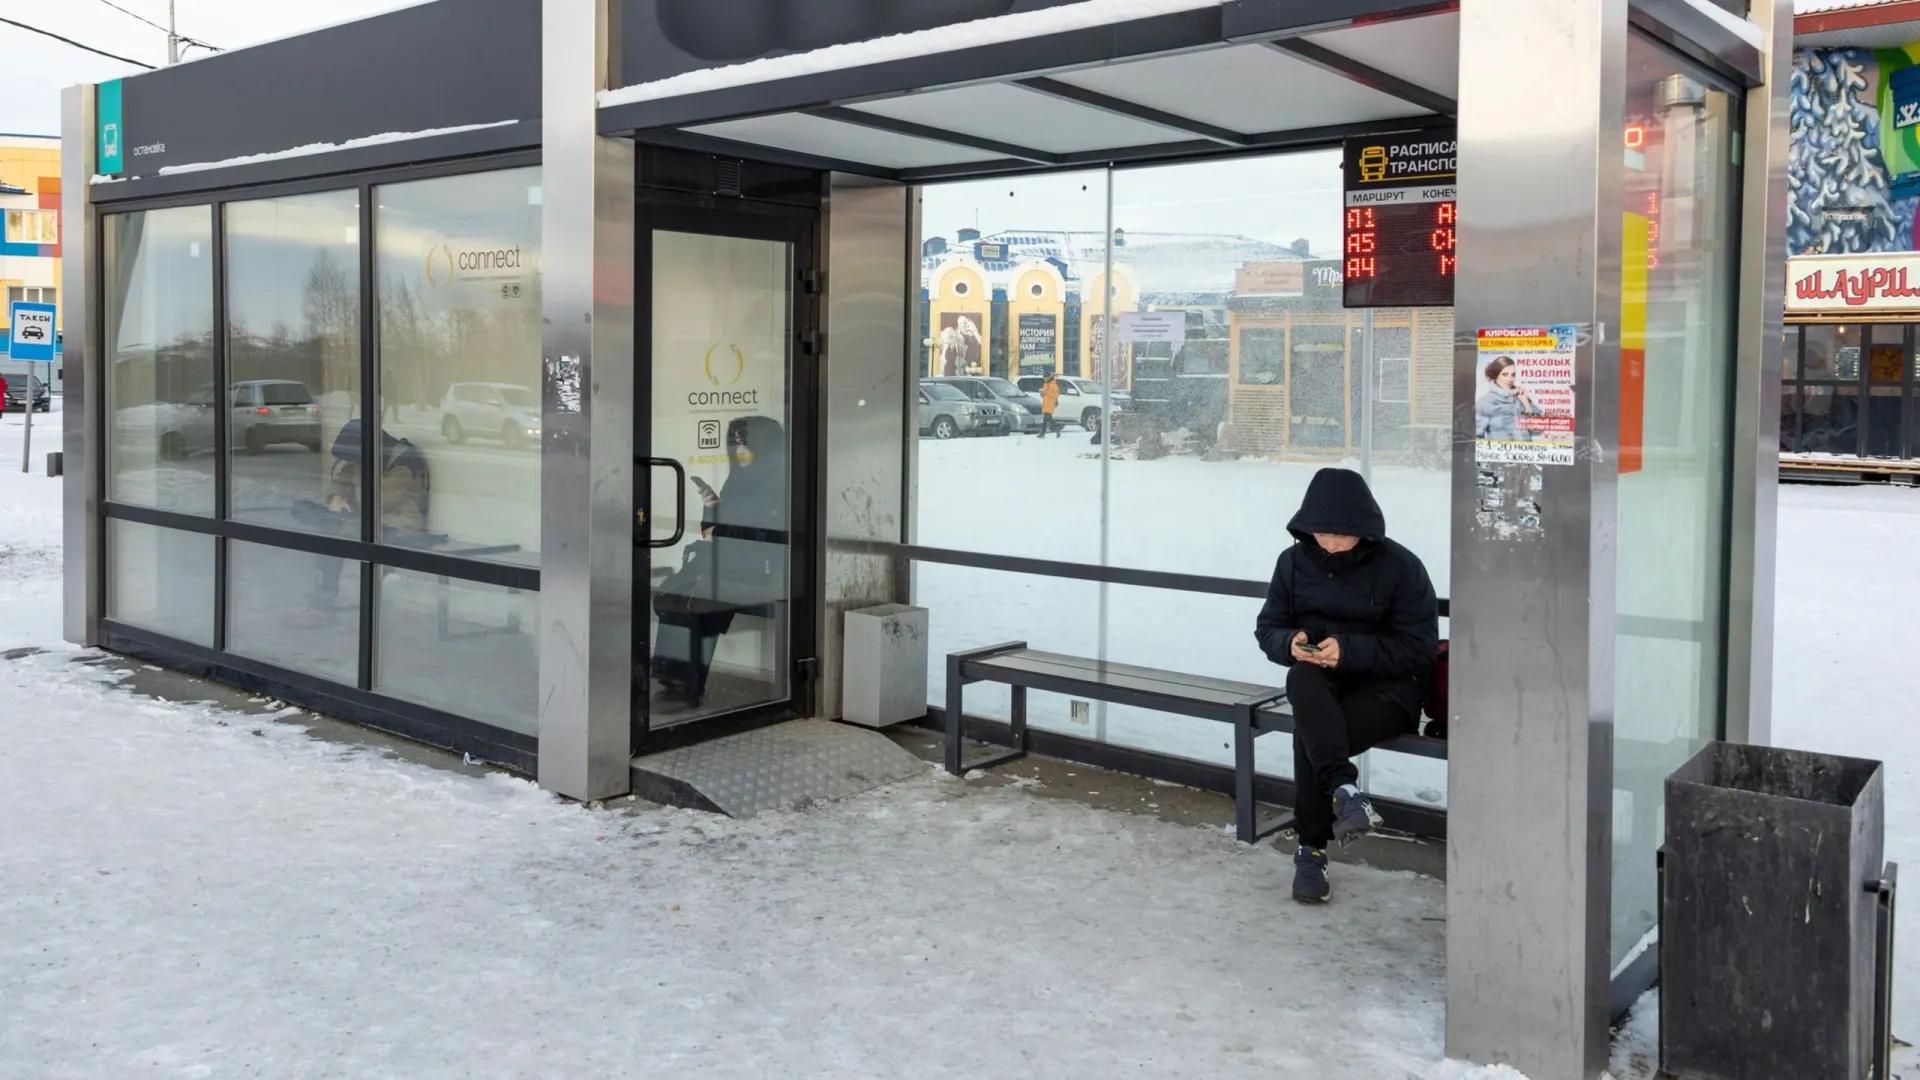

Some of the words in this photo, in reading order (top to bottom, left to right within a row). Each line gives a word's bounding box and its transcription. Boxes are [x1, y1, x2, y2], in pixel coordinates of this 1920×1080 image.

[1353, 191, 1405, 203] МАРШРУТ
[458, 244, 520, 270] connect
[1795, 266, 1920, 305] ШАУРМ
[19, 313, 51, 323] ТАКСИ
[1020, 328, 1055, 337] ИСТОРИЯ
[1484, 328, 1540, 337] КИРОВСКАЯ
[1021, 336, 1050, 344] ДОВЕРЯЕТ
[1020, 343, 1036, 351] НАМ
[1516, 358, 1571, 367] МЕХОВЫХ
[688, 388, 759, 405] connect
[701, 437, 717, 446] FREE
